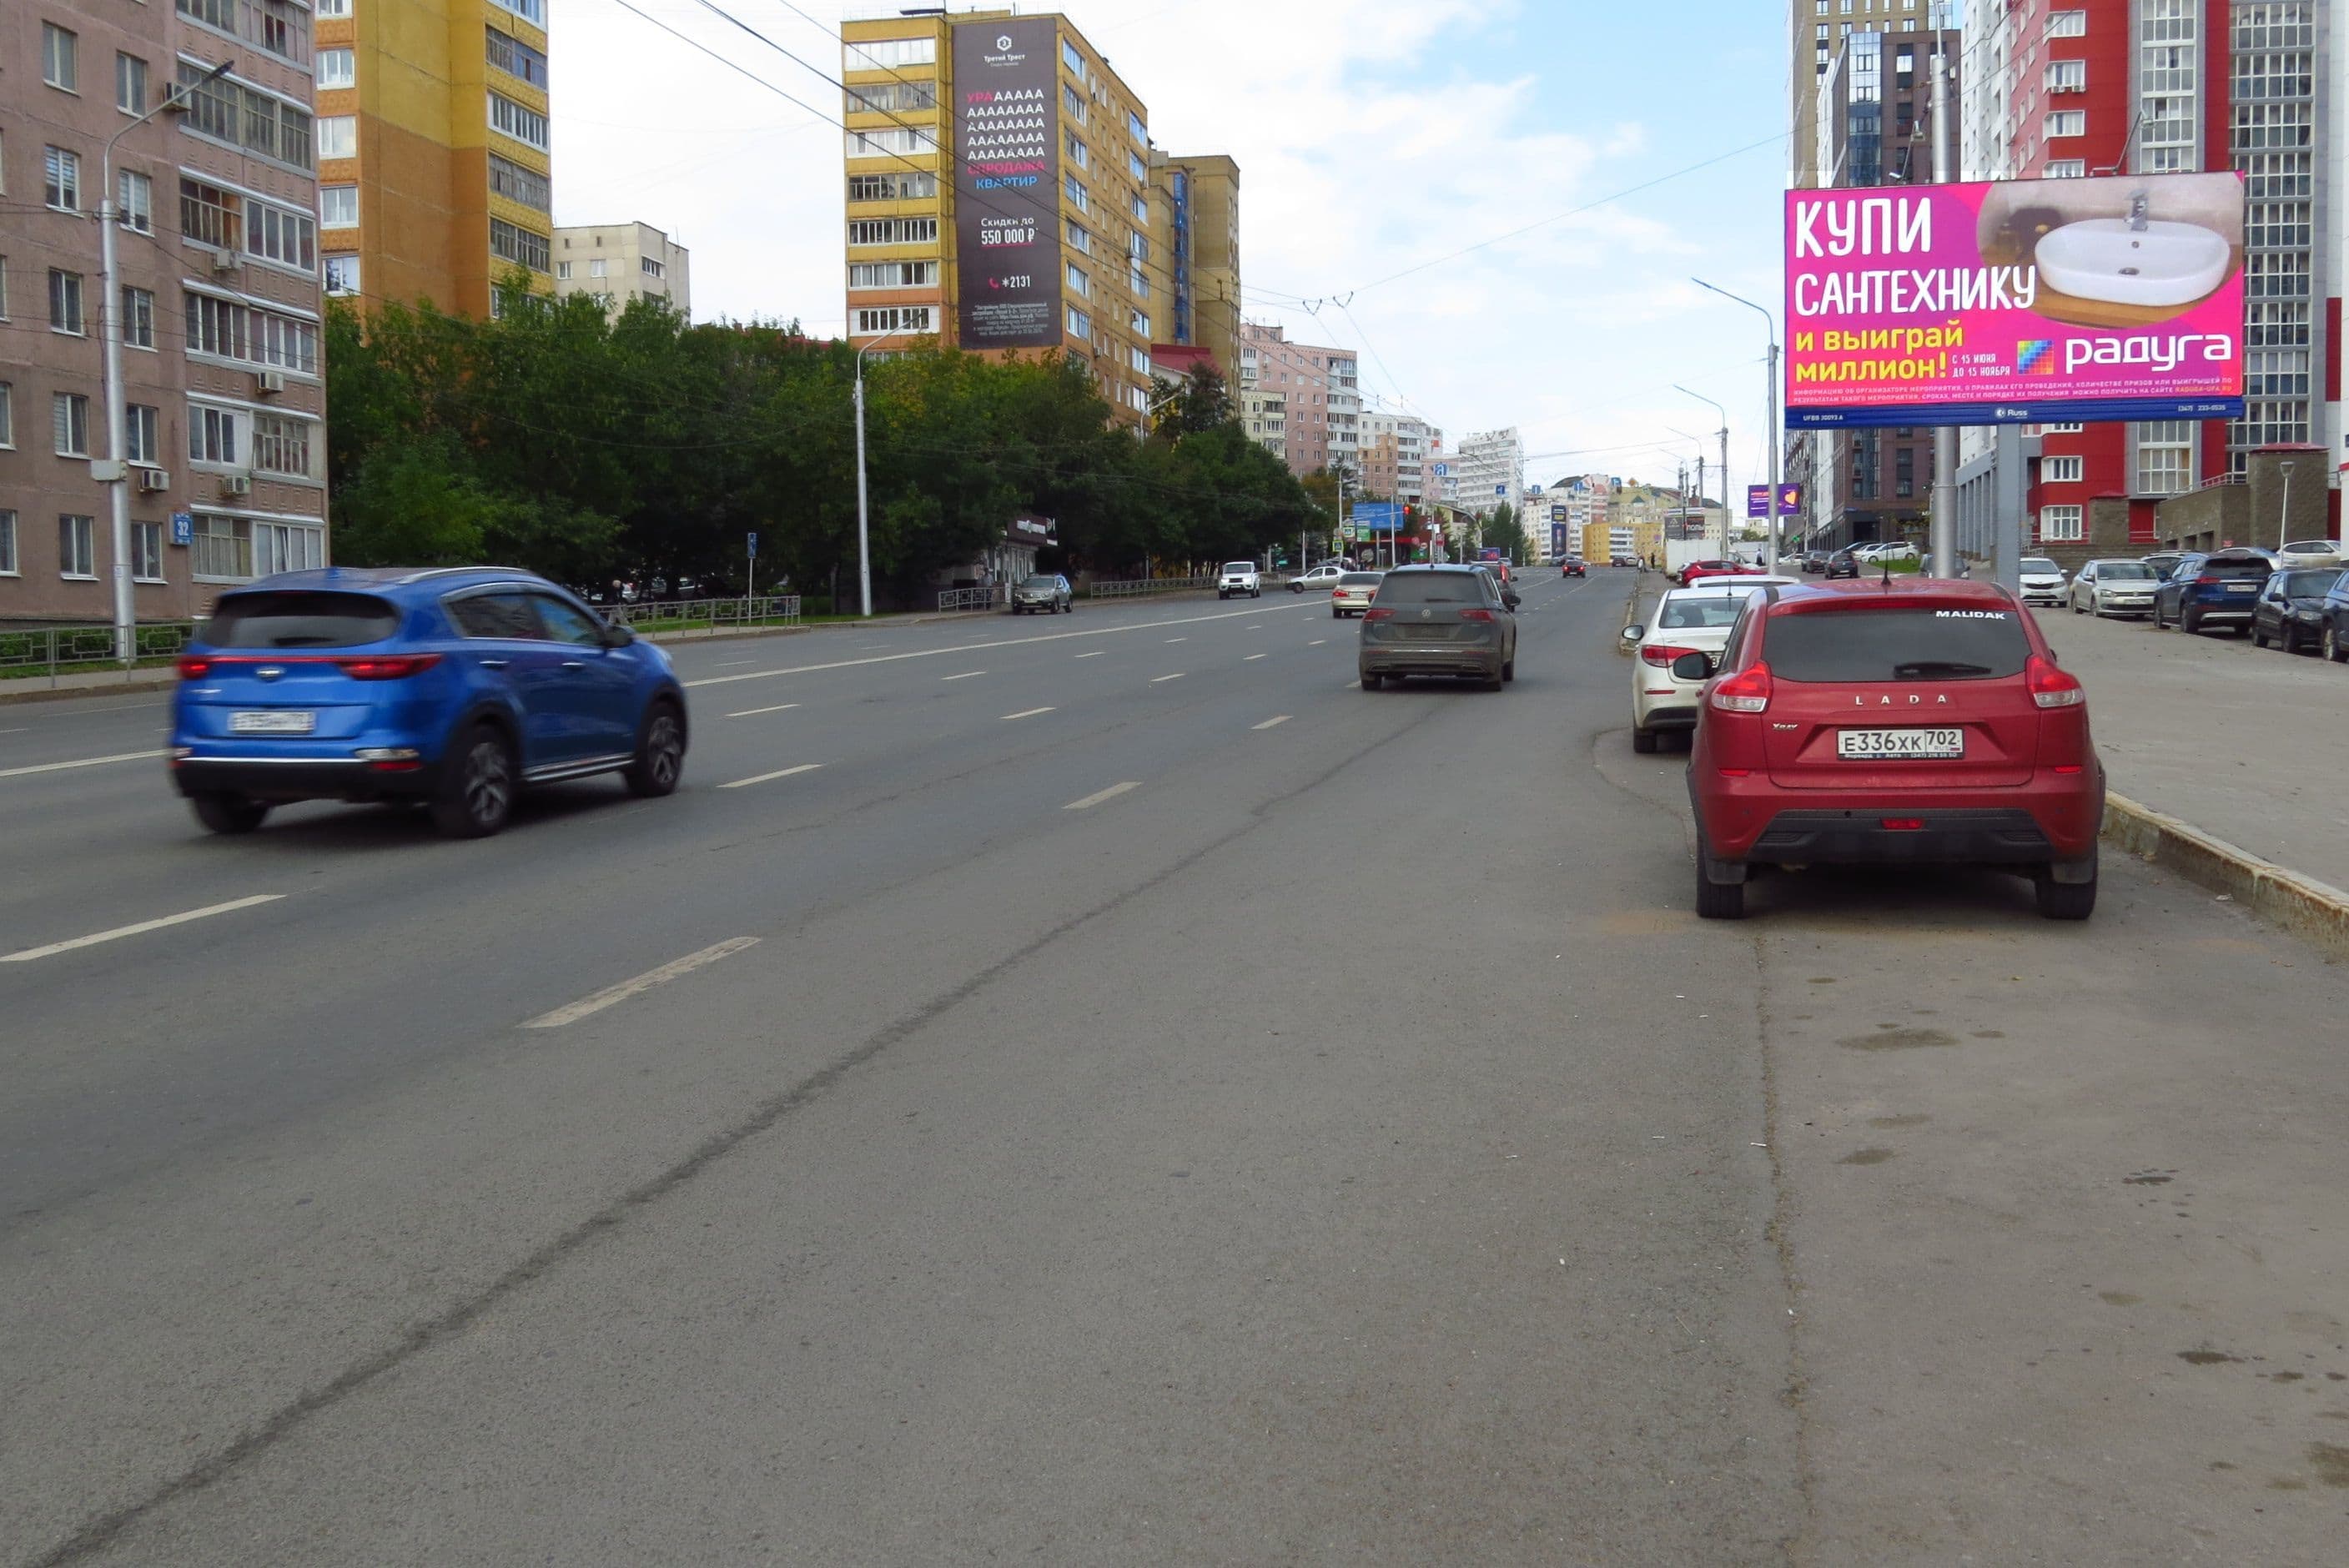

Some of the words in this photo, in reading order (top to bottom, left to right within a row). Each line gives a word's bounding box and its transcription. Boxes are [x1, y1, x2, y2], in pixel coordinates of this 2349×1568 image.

[984, 54, 1006, 63] Третий
[1008, 53, 1025, 62] Трест
[976, 176, 1038, 189] КВАРТИР
[981, 218, 1018, 228] Скидки
[1021, 218, 1034, 226] до
[1796, 198, 1931, 259] КУПИ
[981, 229, 1001, 245] 550
[1004, 229, 1024, 244] 000
[1795, 265, 2035, 316] САНТЕХНИКУ
[1796, 332, 1813, 352] и
[1823, 319, 1963, 354] выиграй
[1952, 355, 1957, 364] С
[1961, 354, 1969, 364] 15
[1974, 354, 1996, 364] ИЮНЯ
[2065, 334, 2231, 374] радуга
[1796, 351, 1946, 383] миллион!
[1952, 368, 1964, 378] ДО
[1969, 367, 1977, 377] 15
[1980, 366, 2010, 376] НОЯБРЯ
[178, 521, 189, 535] 32
[1935, 611, 2006, 620] MALIDAK
[1855, 695, 1947, 706] LADA
[1927, 731, 1957, 745] 702
